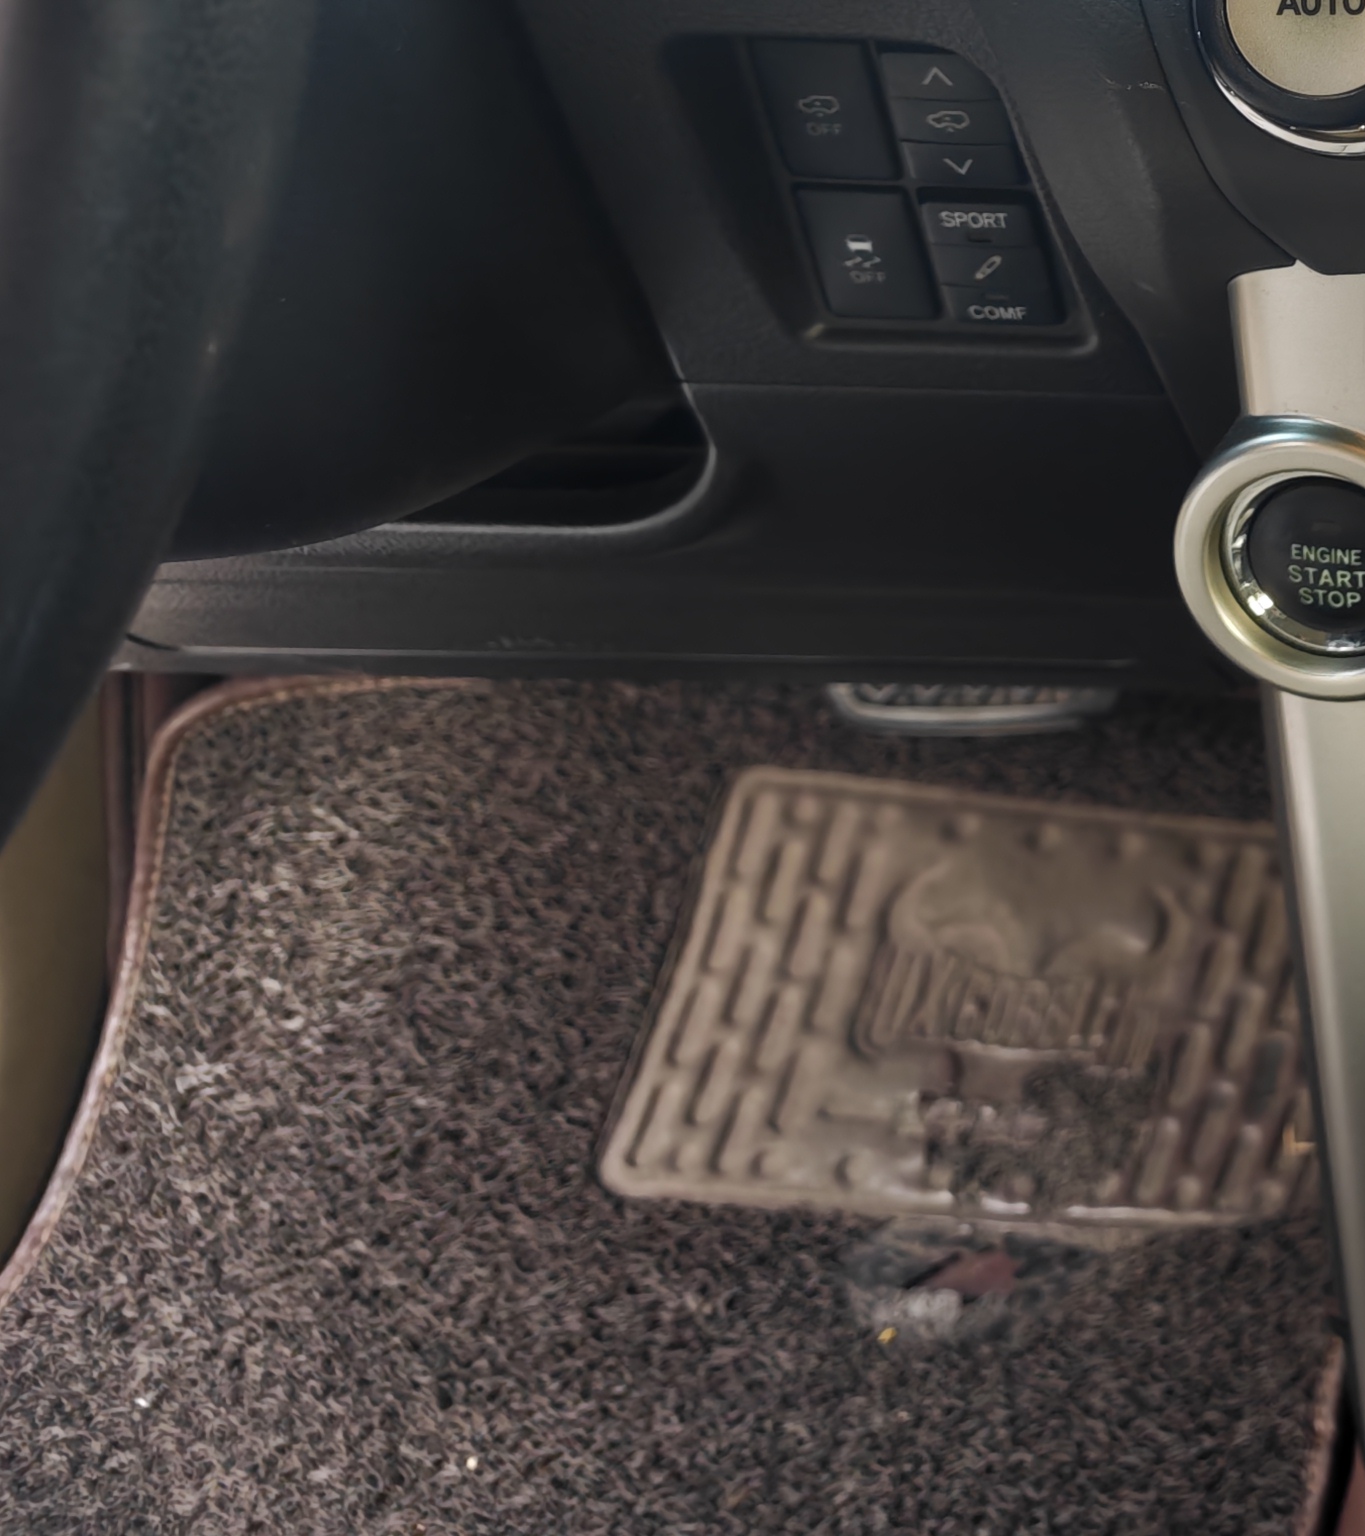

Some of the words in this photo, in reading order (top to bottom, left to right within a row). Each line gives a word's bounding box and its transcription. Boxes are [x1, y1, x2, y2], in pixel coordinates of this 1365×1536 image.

[806, 121, 843, 137] OFF
[939, 211, 1009, 230] SPORT
[967, 304, 1028, 321] COMF
[1290, 543, 1363, 566] ENGINE
[1299, 587, 1362, 609] STOP
